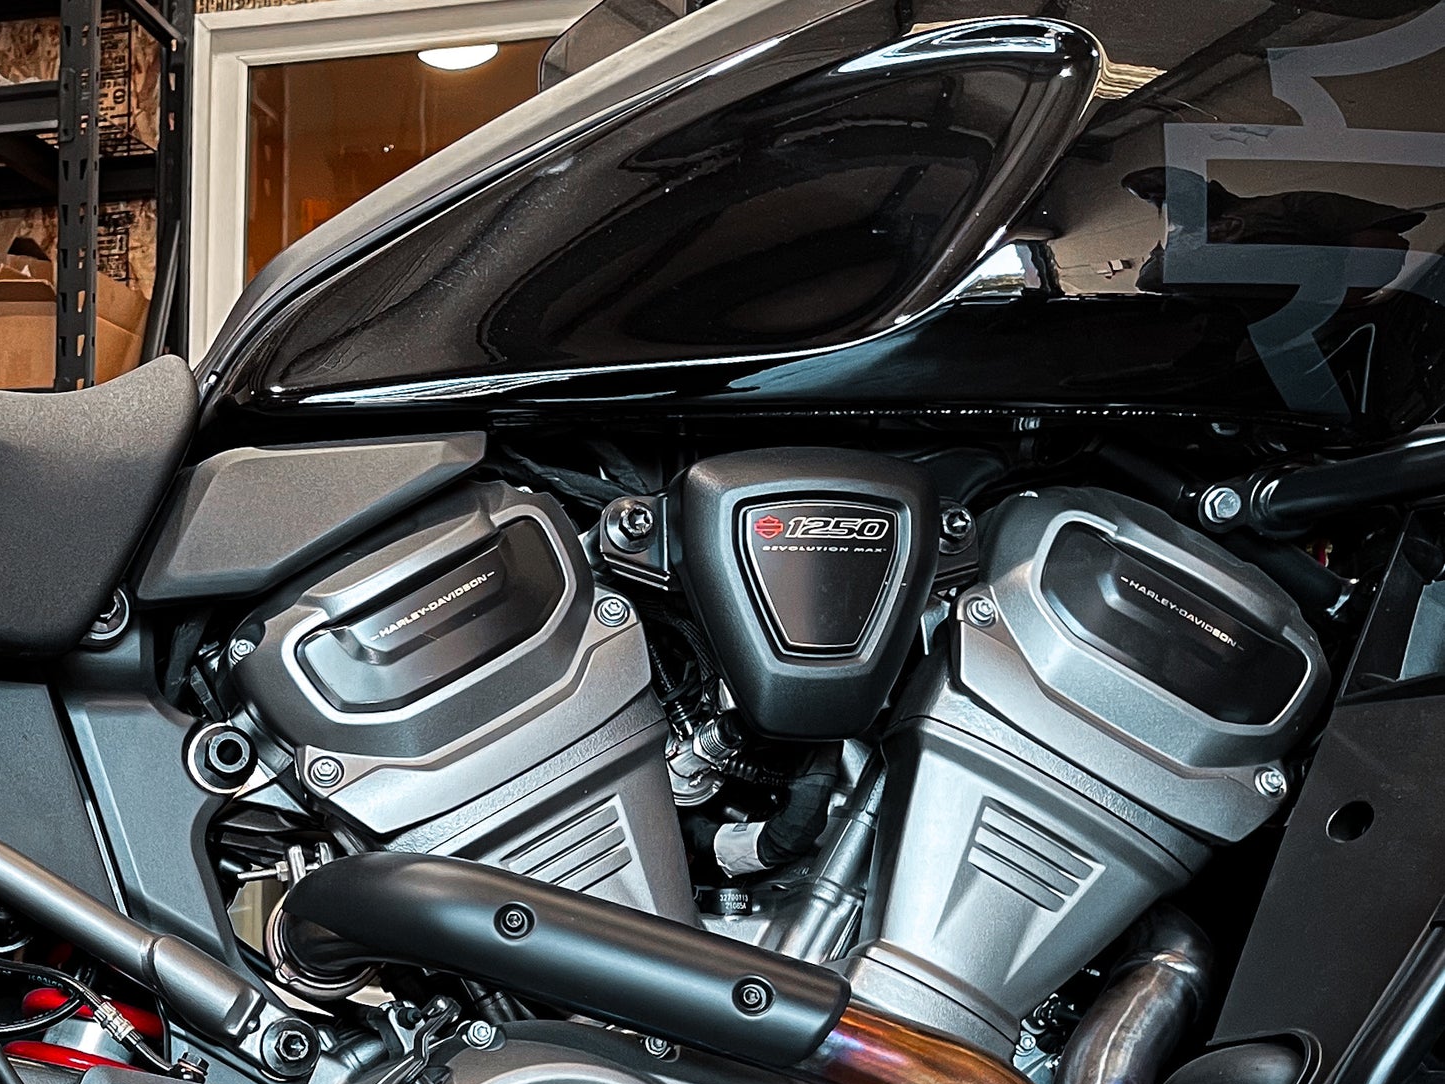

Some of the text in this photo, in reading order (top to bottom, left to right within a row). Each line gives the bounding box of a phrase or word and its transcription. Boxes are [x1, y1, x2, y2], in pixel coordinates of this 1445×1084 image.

[785, 515, 890, 540] 1250
[761, 545, 884, 554] REVOLUTION MAX
